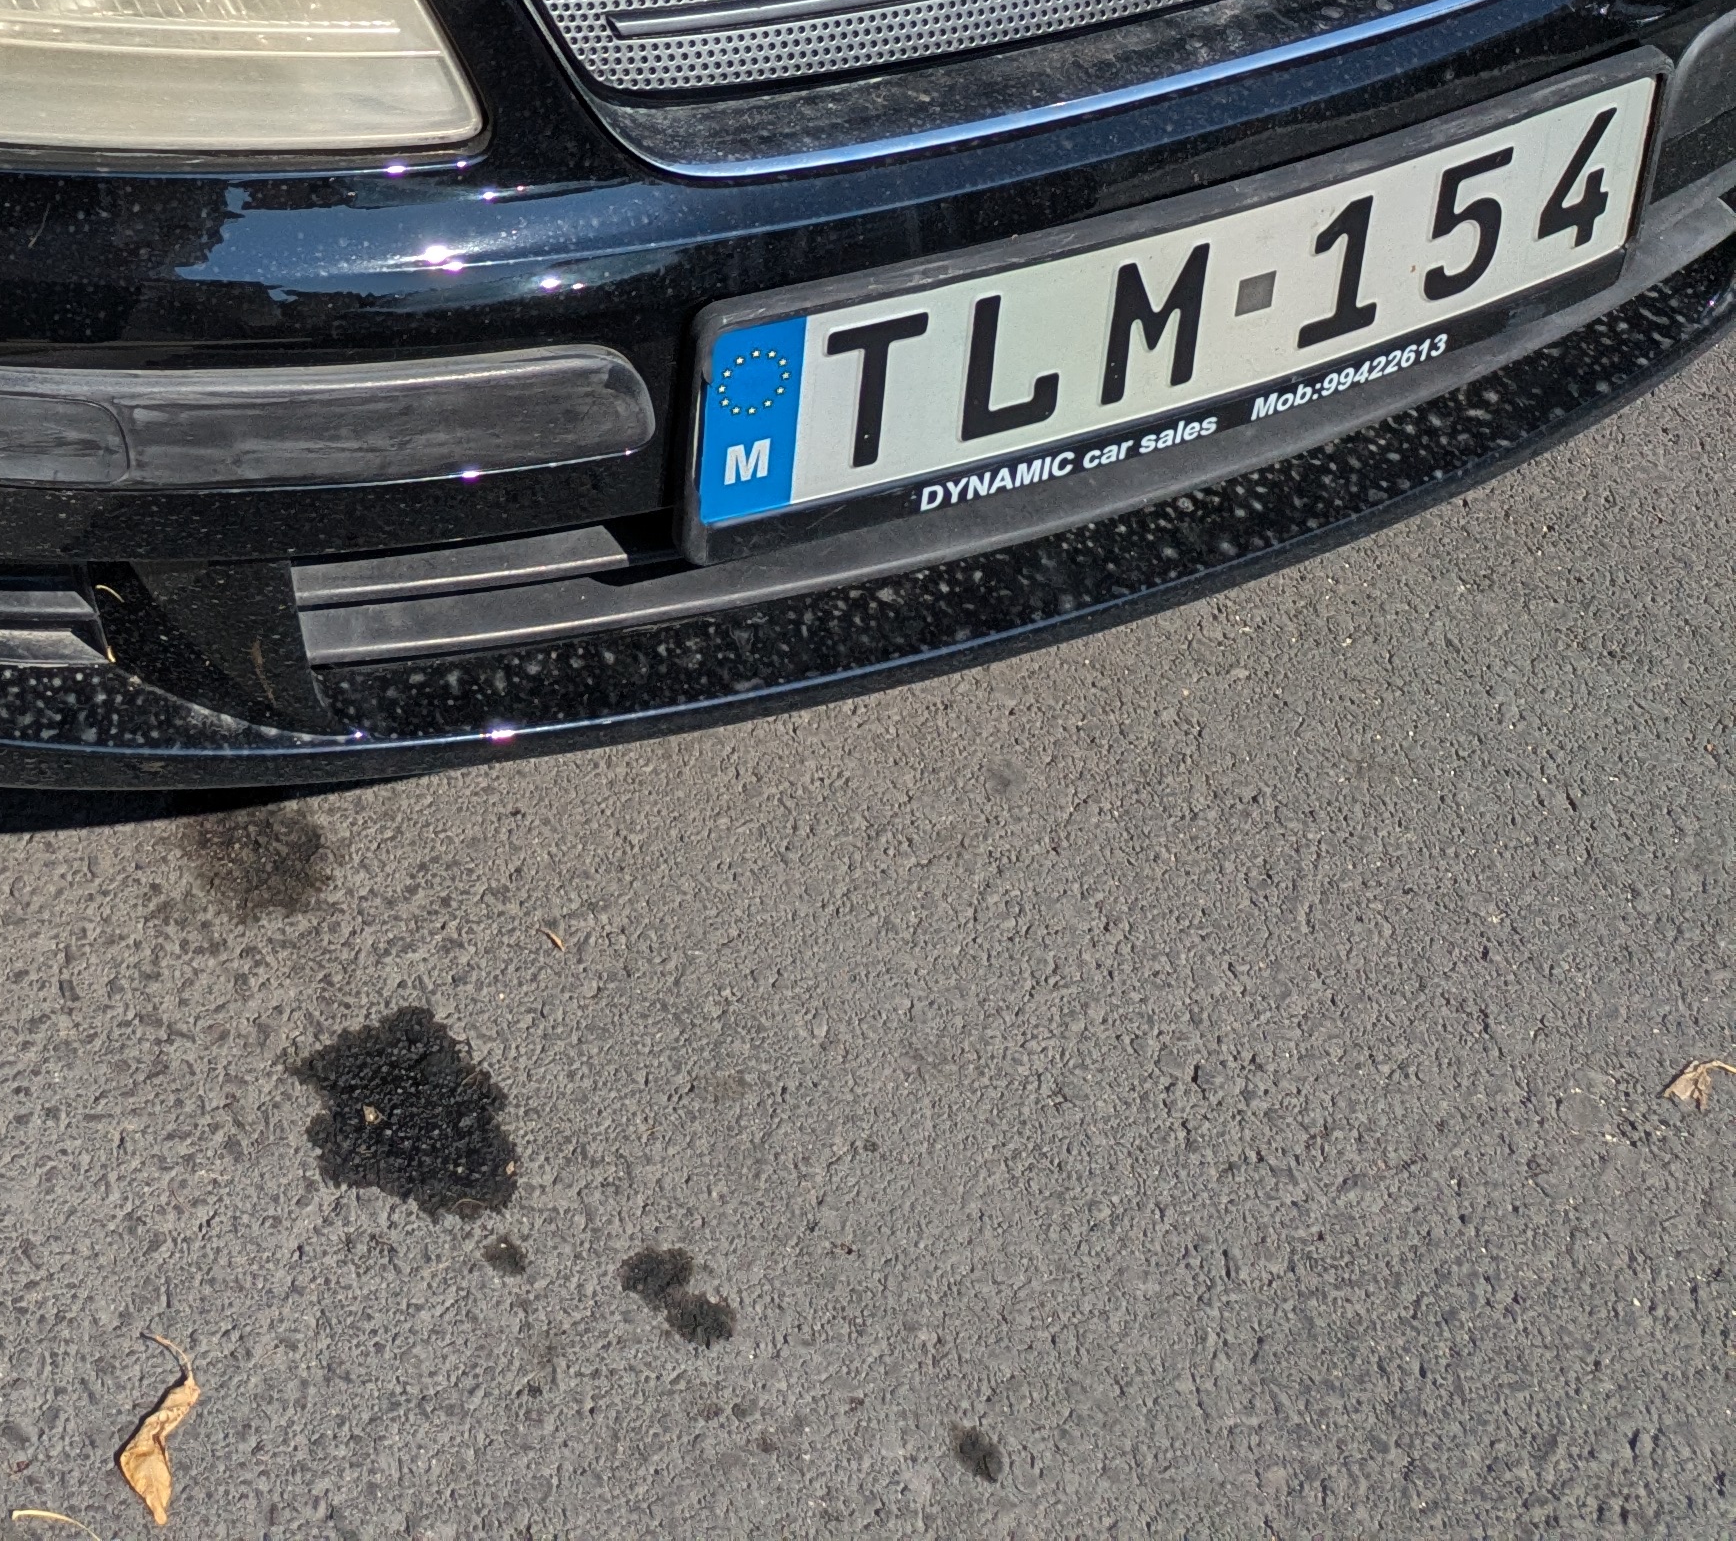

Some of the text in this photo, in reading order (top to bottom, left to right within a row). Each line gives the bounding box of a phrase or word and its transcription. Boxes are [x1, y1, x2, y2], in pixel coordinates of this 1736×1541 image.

[723, 437, 770, 487] M
[918, 333, 1450, 514] DYNAMIC car sales Mob:99422613
